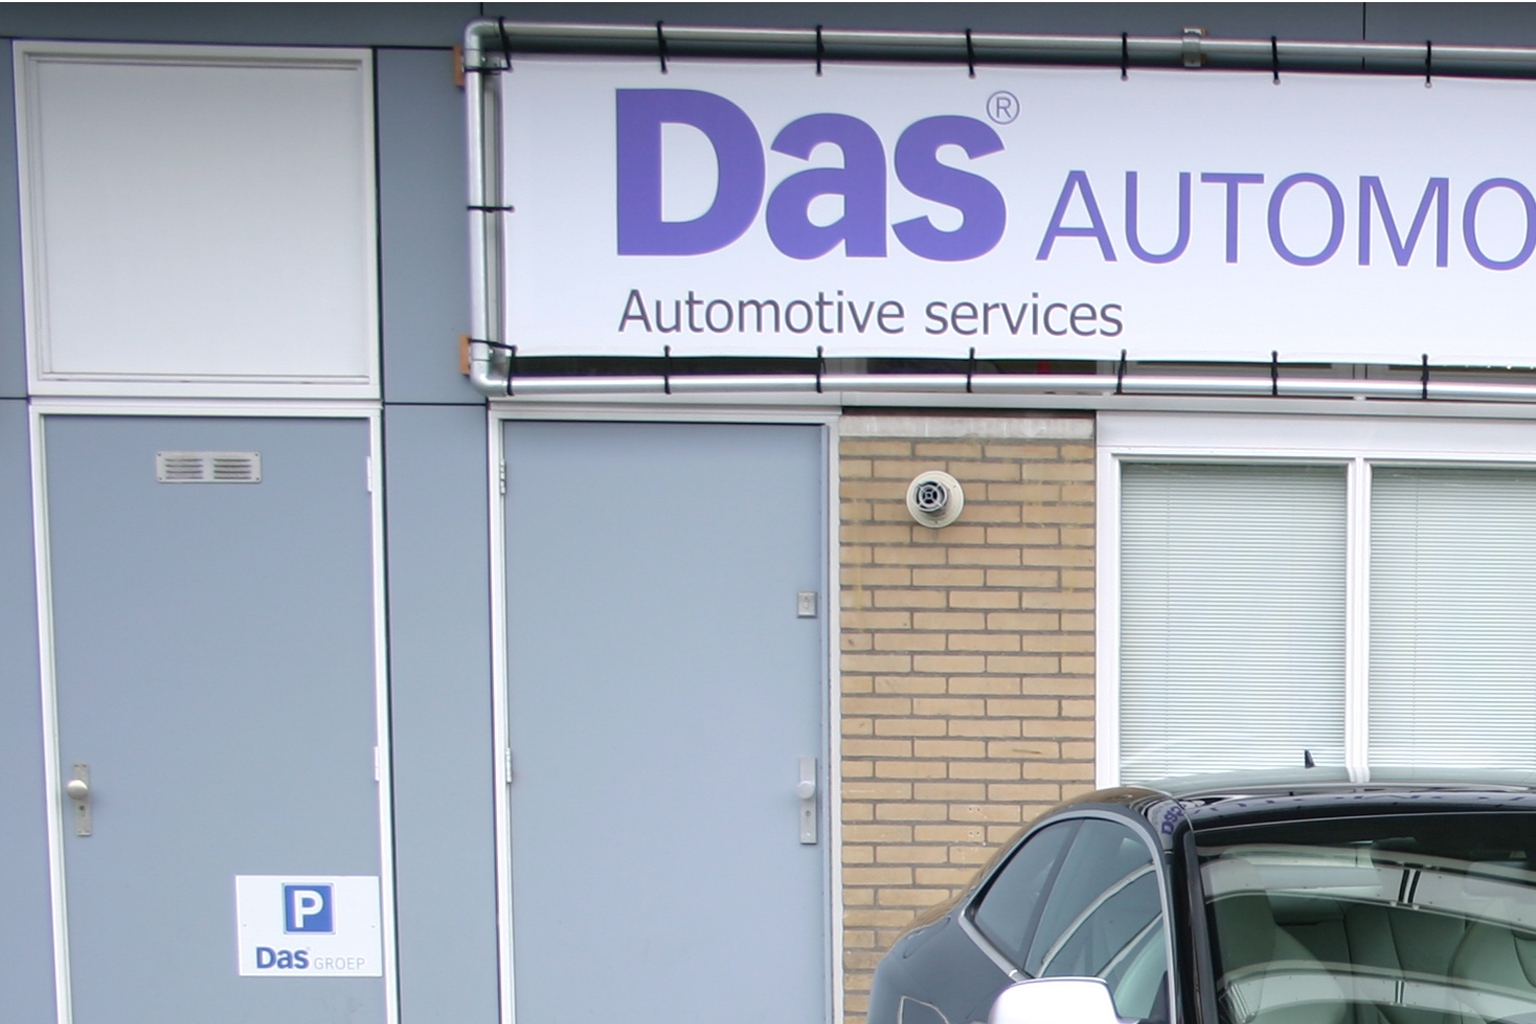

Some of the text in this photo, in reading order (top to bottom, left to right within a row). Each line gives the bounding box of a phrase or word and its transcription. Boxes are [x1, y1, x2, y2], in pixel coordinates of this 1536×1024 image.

[618, 288, 1124, 337] Automotive services
[293, 889, 324, 929] P
[256, 946, 366, 971] Das GROEP
